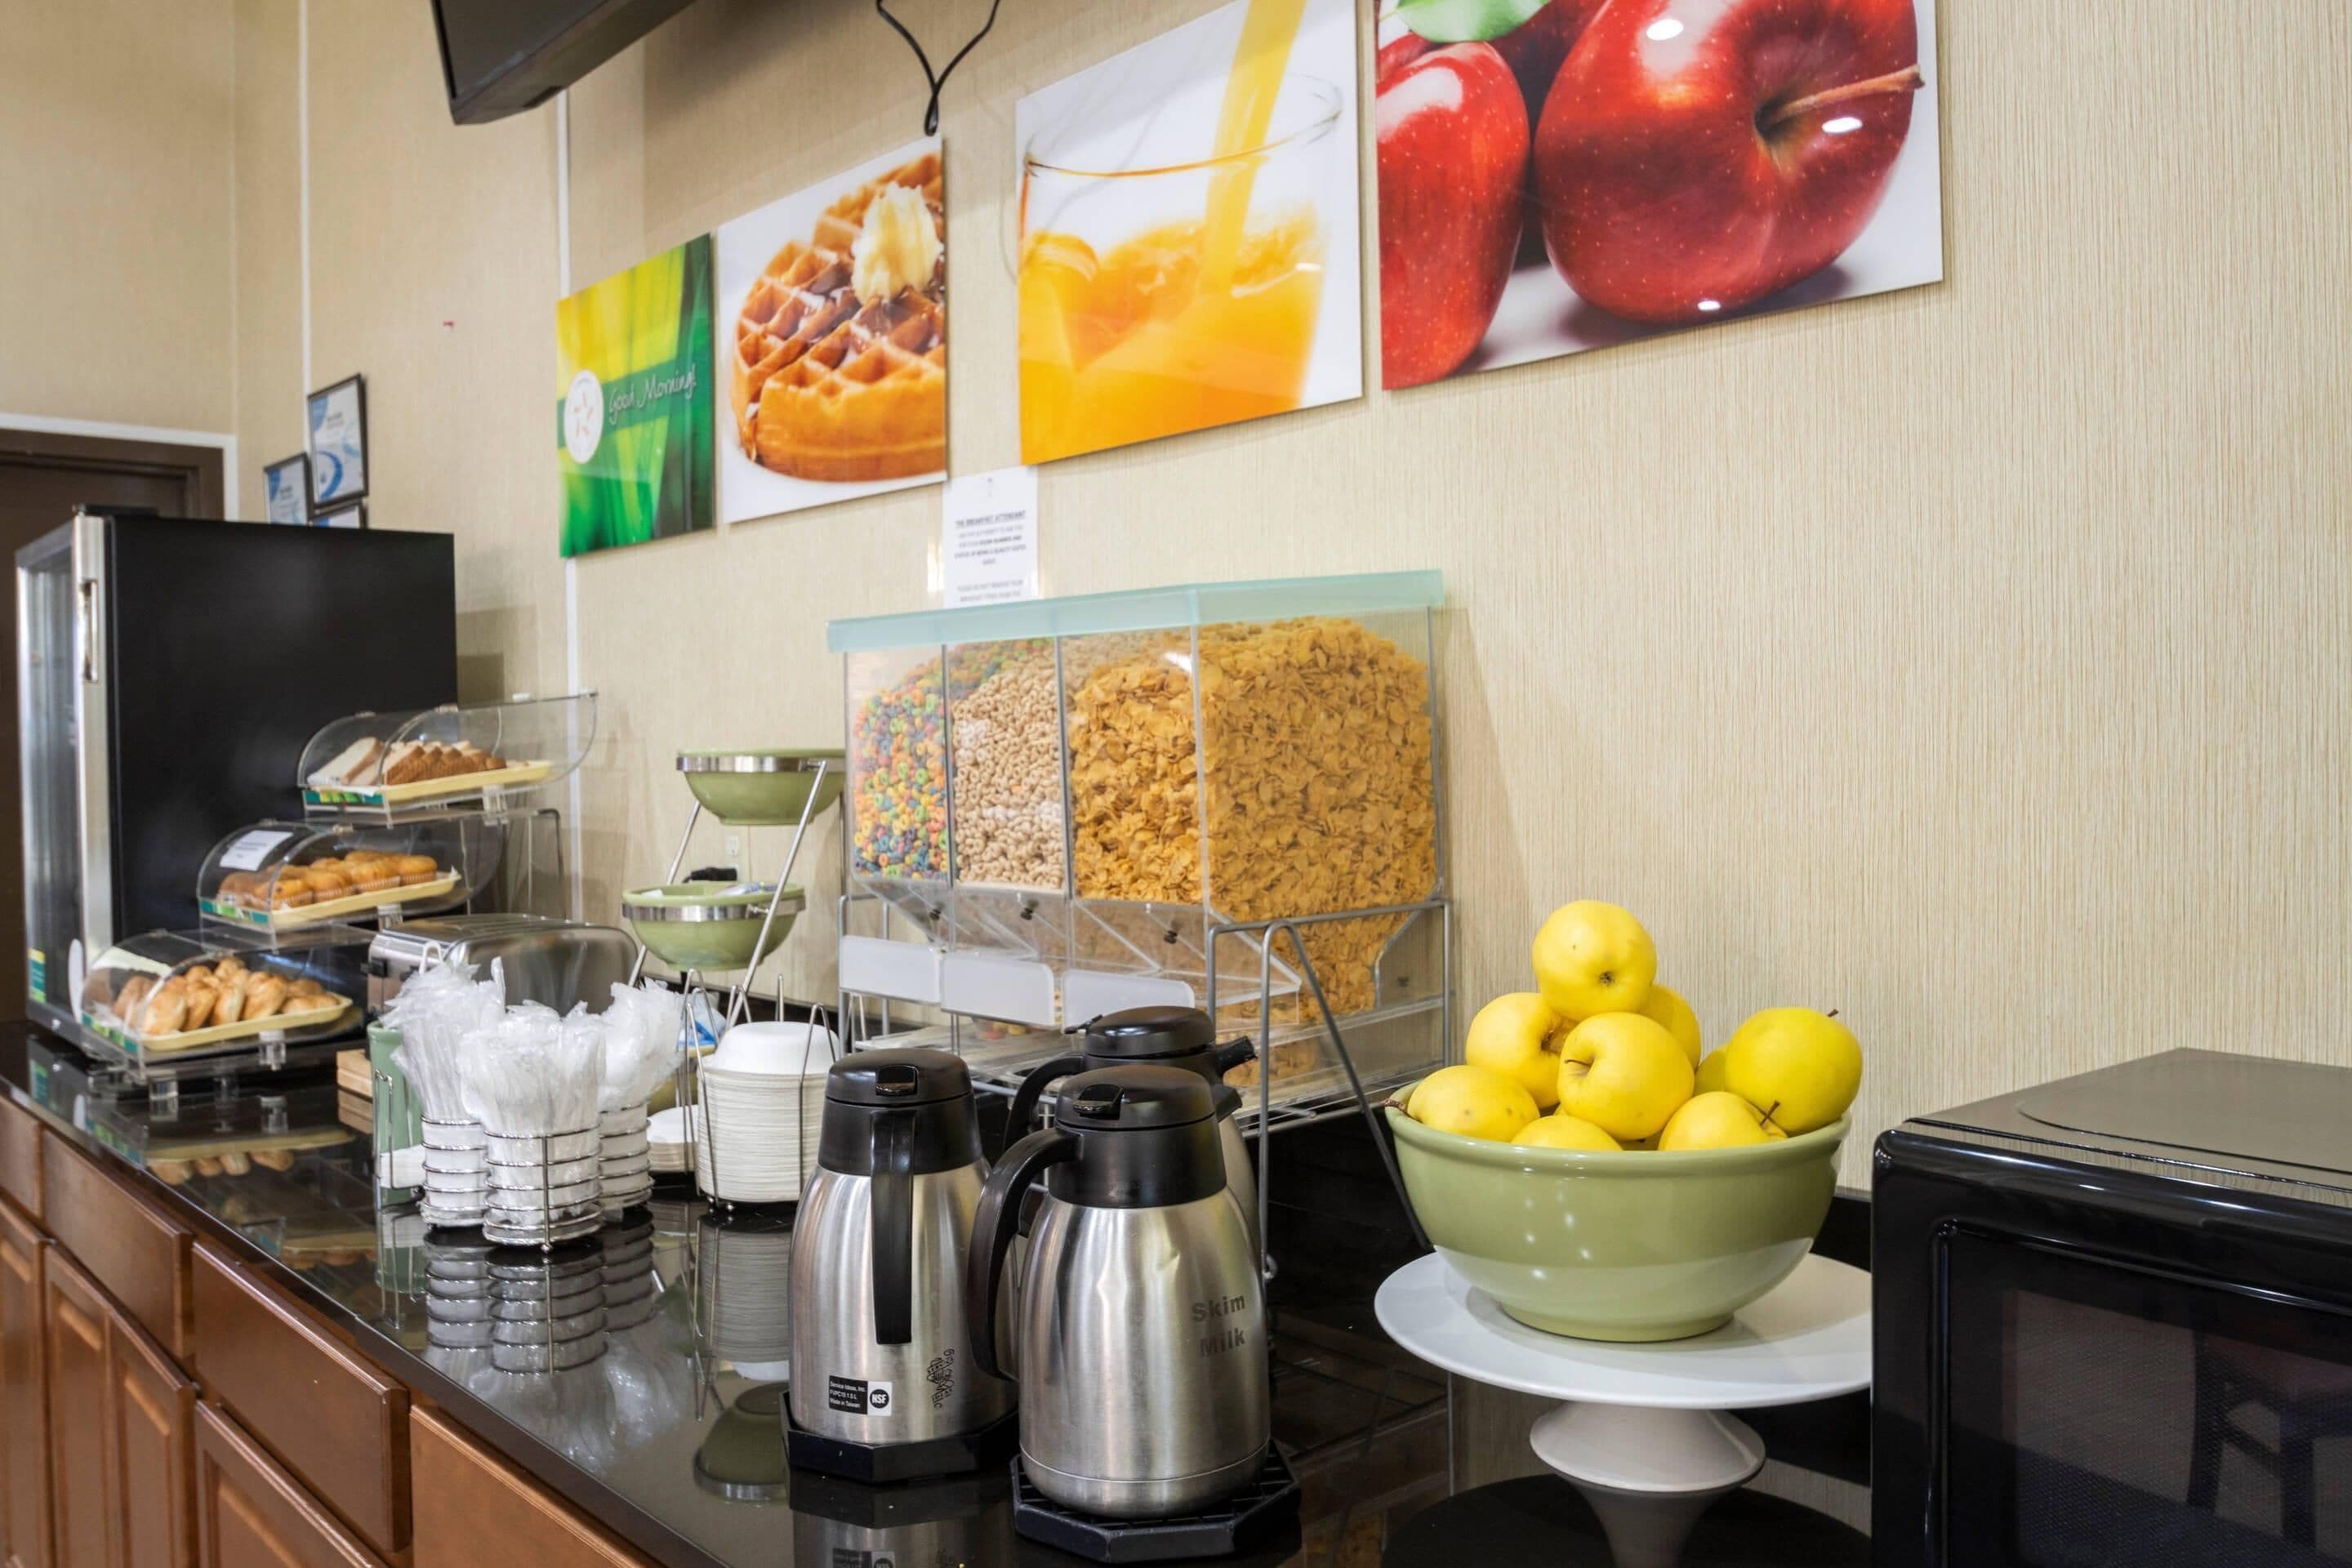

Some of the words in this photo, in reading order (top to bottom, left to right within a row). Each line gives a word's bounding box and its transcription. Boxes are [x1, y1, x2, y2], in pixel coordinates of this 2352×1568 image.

[1192, 1295, 1245, 1322] Skim
[1200, 1328, 1245, 1357] Milk
[871, 1392, 888, 1405] NSF
